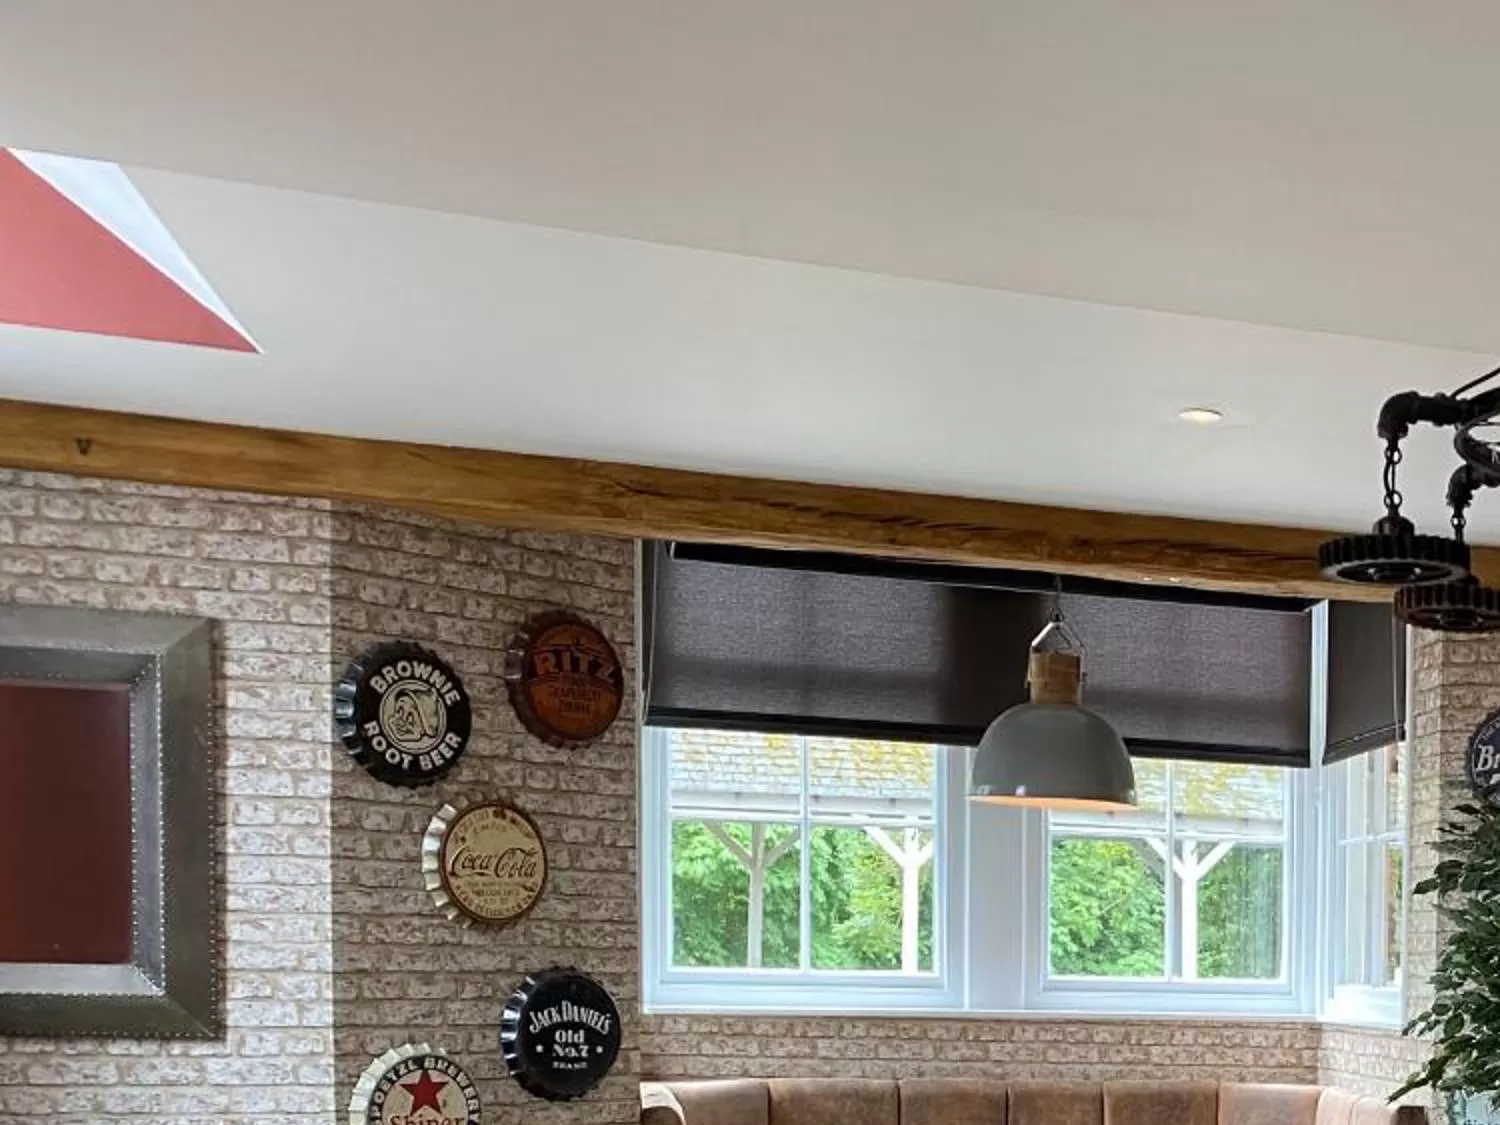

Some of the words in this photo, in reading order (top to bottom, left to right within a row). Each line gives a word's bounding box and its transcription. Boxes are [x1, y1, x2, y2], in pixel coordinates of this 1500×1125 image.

[369, 660, 461, 706] BROWNIE
[533, 651, 615, 684] RITZ
[363, 720, 413, 769] ROOT
[419, 732, 462, 771] BEER
[529, 1005, 561, 1034] JACK
[555, 1030, 585, 1043] Old
[424, 1057, 480, 1123] BREWERY
